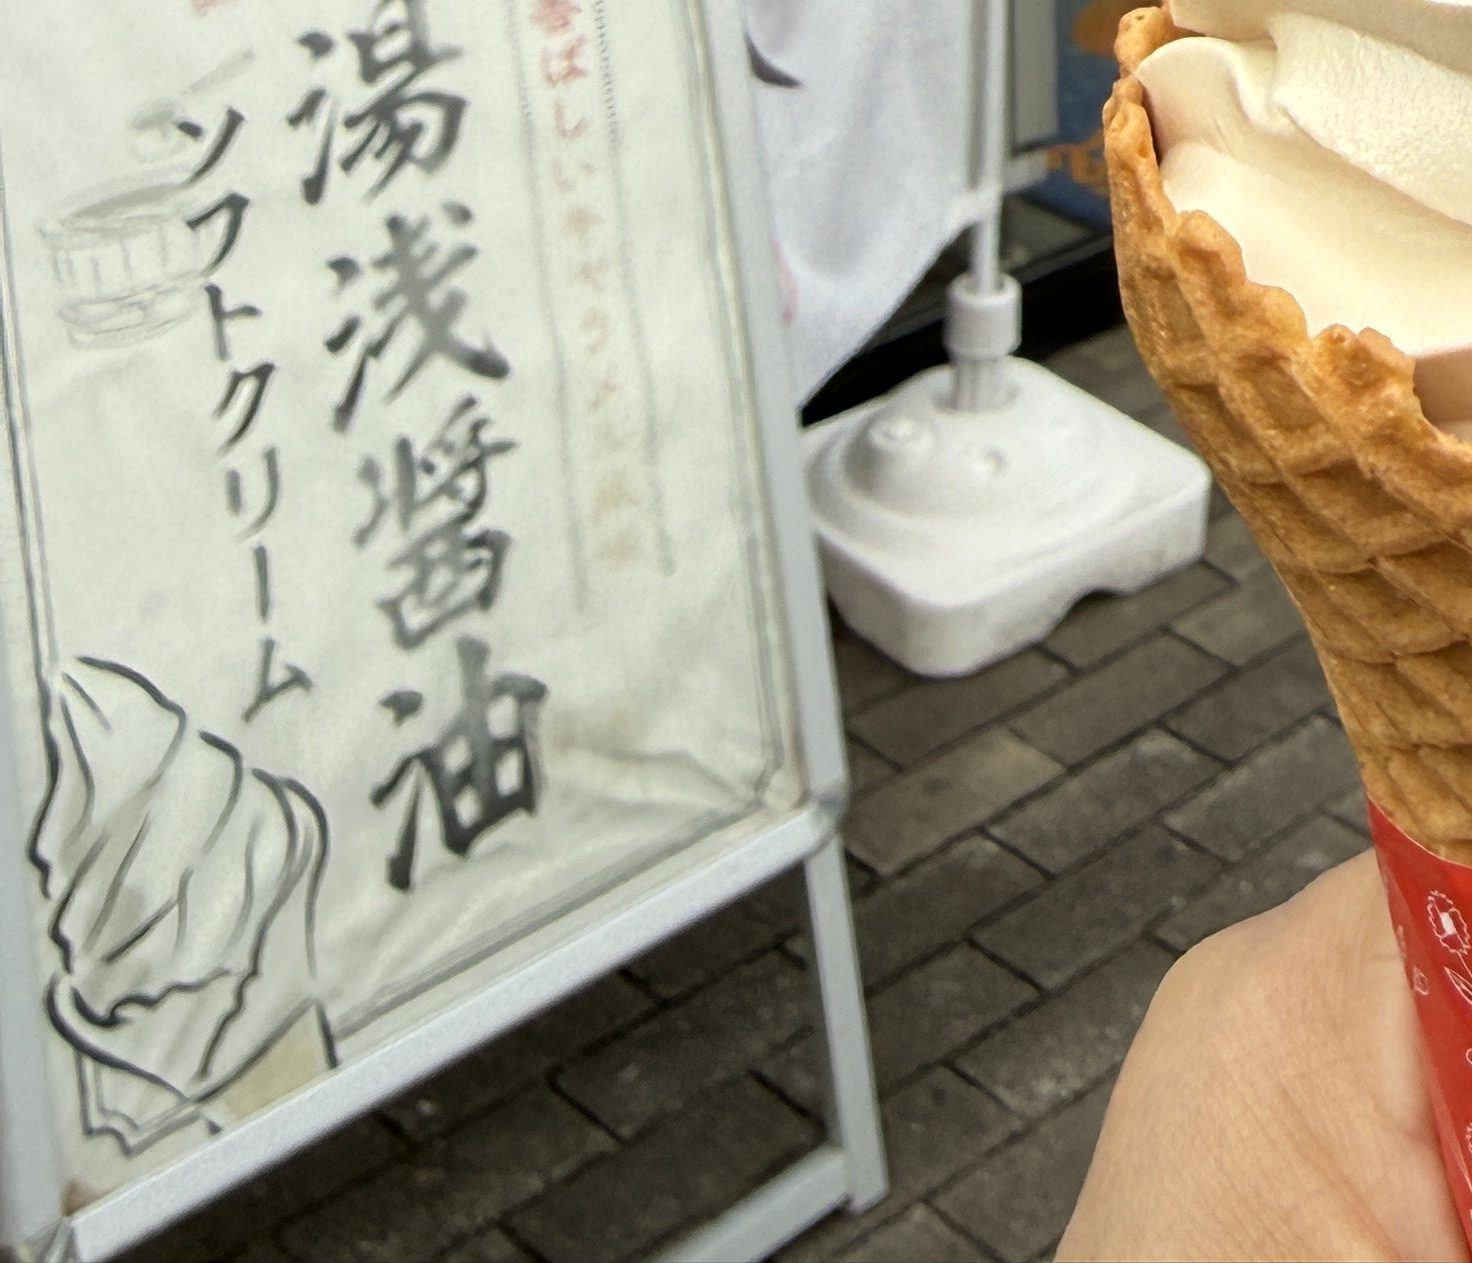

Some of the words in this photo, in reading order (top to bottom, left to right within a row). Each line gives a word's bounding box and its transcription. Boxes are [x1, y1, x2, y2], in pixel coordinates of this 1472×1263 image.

[174, 106, 313, 725] ソフトクリーム
